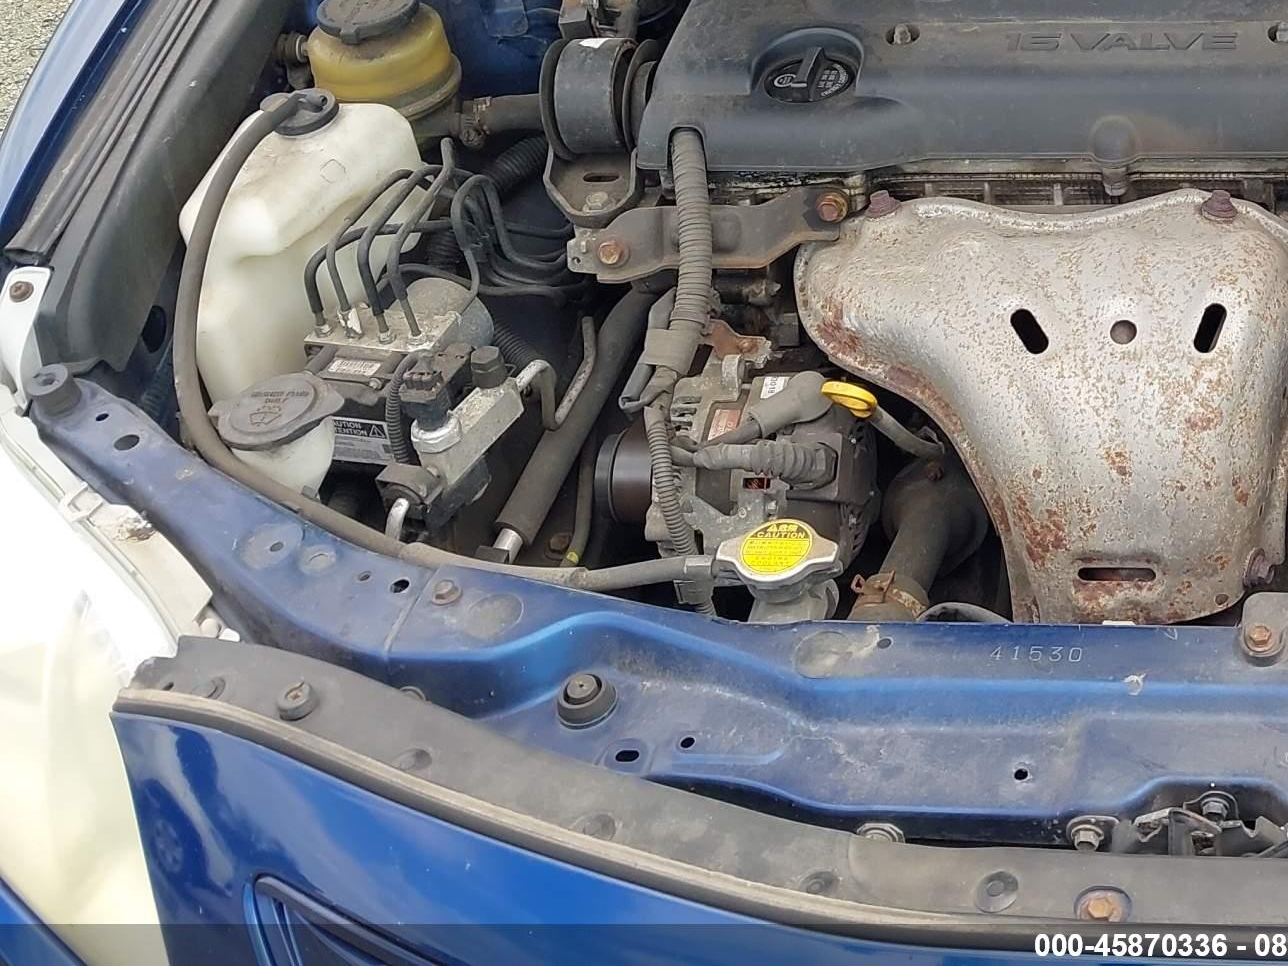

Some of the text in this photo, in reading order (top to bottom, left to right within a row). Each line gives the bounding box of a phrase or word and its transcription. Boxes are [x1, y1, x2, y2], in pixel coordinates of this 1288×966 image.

[1006, 32, 1238, 51] 16 VALVE
[757, 531, 806, 539] CAUTION
[989, 645, 1083, 662] 41530
